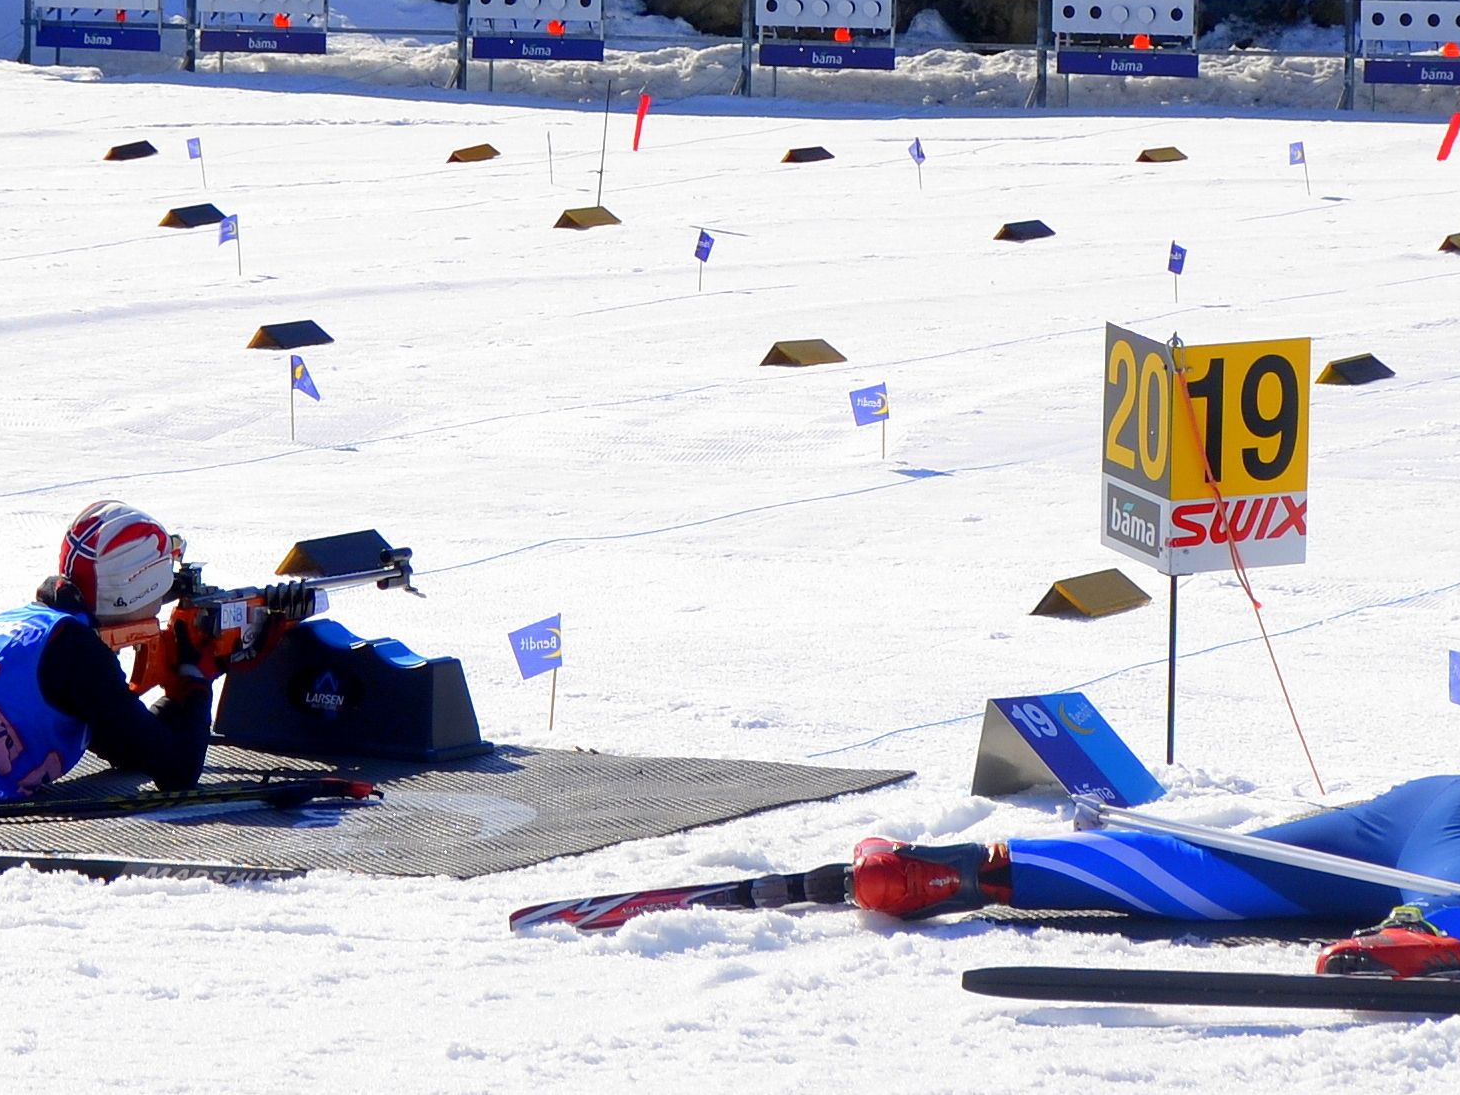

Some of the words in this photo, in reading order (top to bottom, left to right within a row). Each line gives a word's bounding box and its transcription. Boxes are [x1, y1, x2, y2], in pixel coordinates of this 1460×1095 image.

[1106, 340, 1169, 481] 20
[1186, 354, 1299, 484] 19
[1166, 496, 1307, 547] SWIX
[305, 692, 345, 706] LARSEN
[1012, 703, 1058, 738] 19
